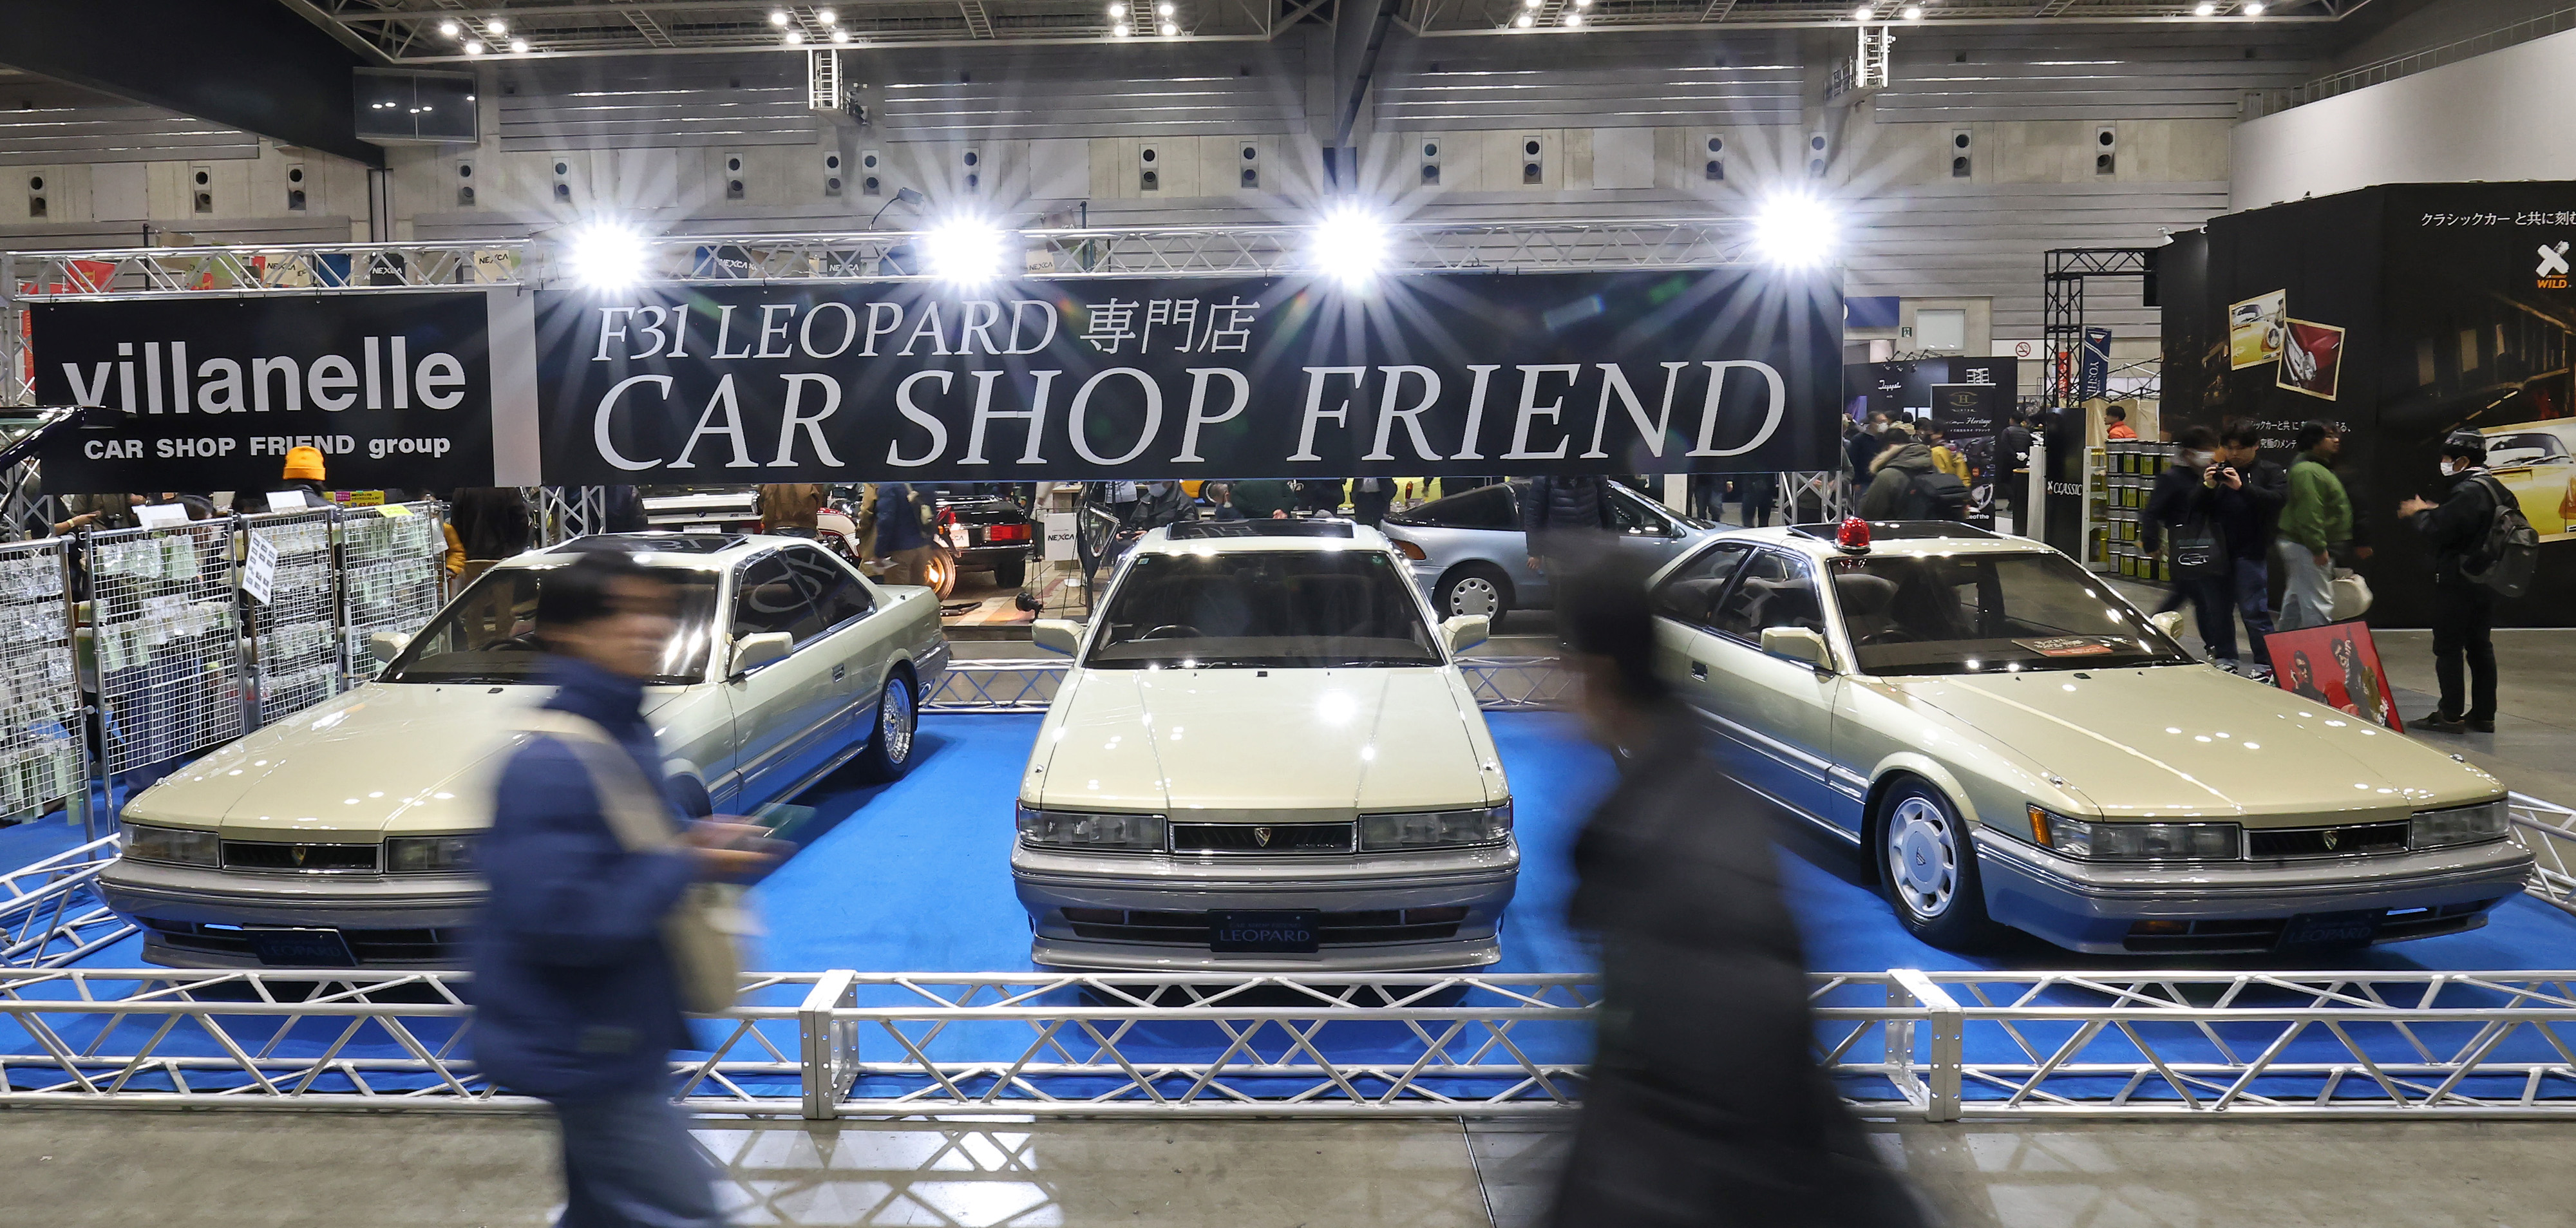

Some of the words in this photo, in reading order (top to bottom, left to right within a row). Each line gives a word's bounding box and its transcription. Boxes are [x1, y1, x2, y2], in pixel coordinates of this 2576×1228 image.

[2537, 279, 2568, 288] WILD
[591, 303, 689, 361] F31
[710, 299, 1058, 359] LEOPARD
[1079, 296, 1260, 354] 専門店
[62, 336, 466, 414] villanelle
[594, 373, 845, 471] CAR
[886, 367, 1250, 467] SHOP
[1286, 359, 1786, 461] FRIEND
[84, 440, 143, 460] CAR
[156, 437, 236, 458] SHOP
[250, 435, 355, 456] FRIEND
[368, 438, 450, 459] group
[1219, 929, 1310, 942] LEOPARD
